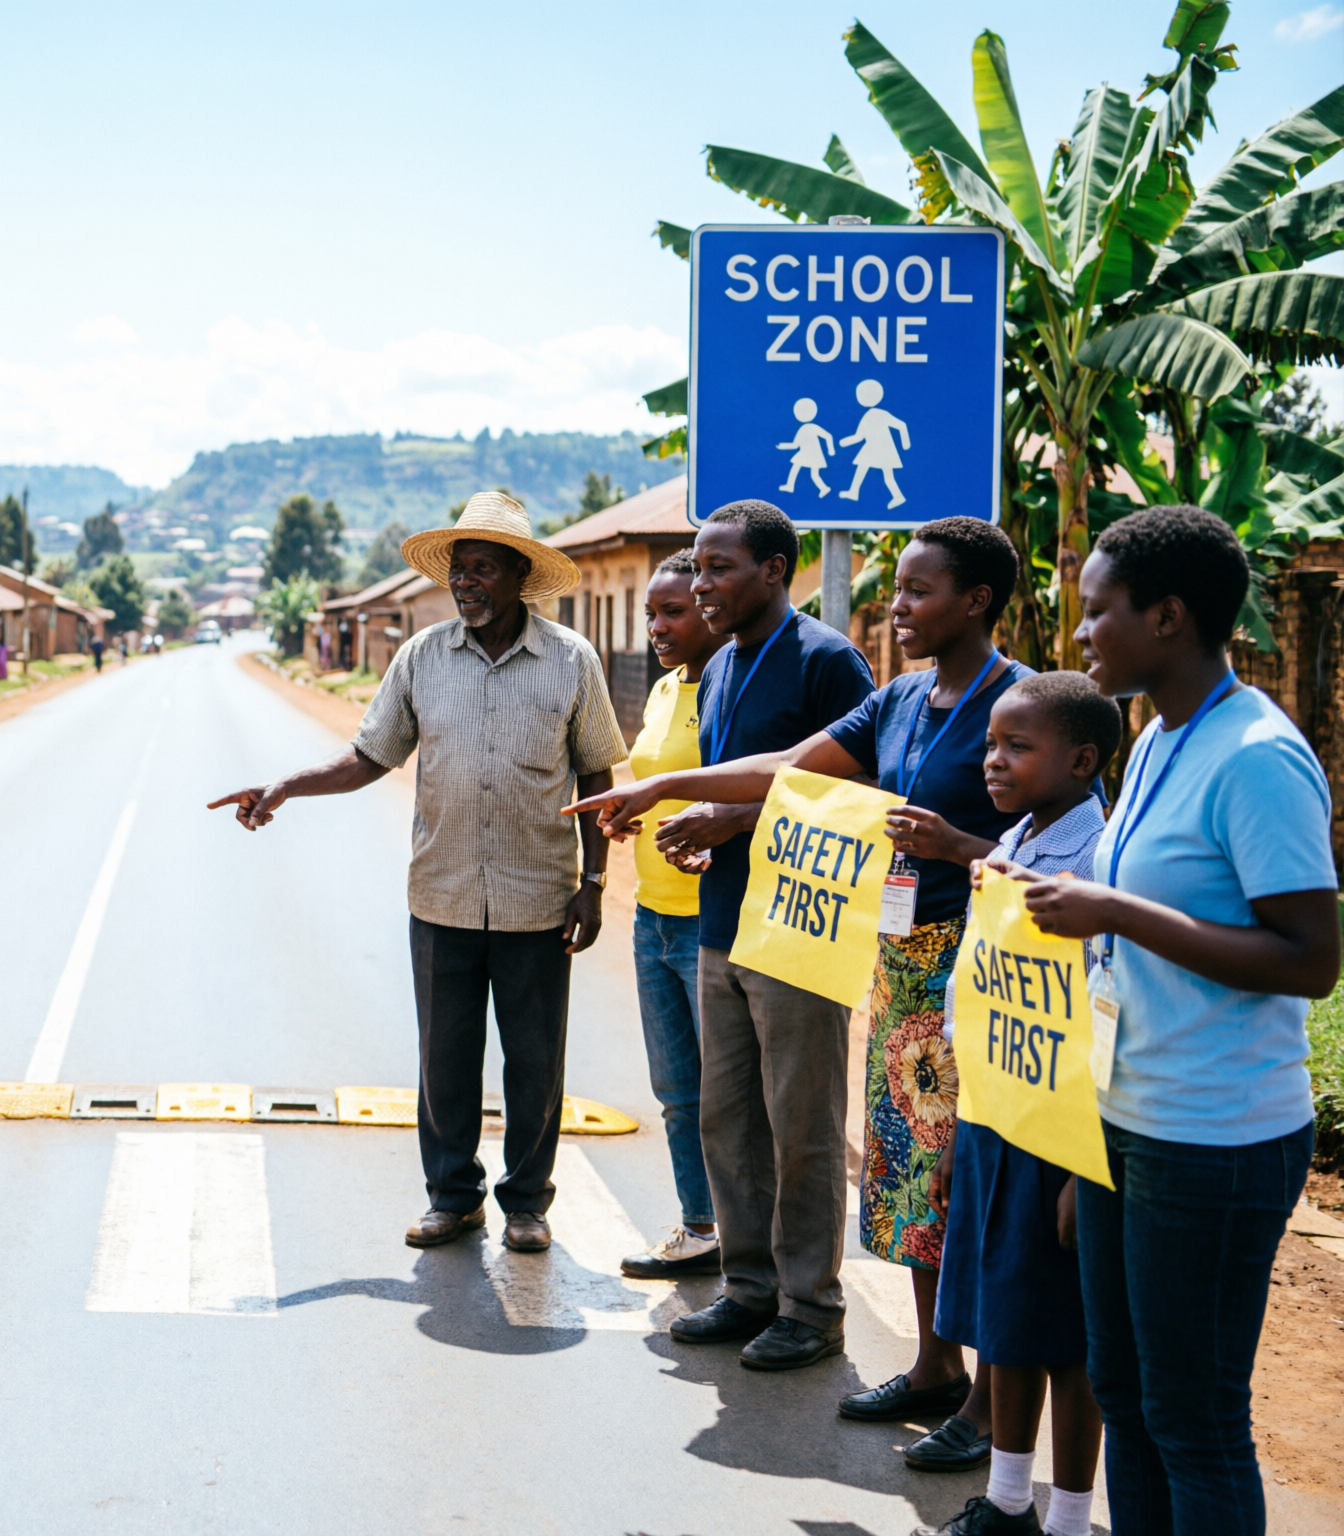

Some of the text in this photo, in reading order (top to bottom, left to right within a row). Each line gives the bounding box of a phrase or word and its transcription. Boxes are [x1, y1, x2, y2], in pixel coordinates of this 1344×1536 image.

[724, 254, 973, 303] SCHOOL
[766, 315, 928, 363] ZONE
[767, 816, 875, 888] SAFETY
[767, 874, 849, 943] FIRST
[972, 938, 1072, 1020] SAFETY
[988, 1008, 1066, 1092] FIRST
